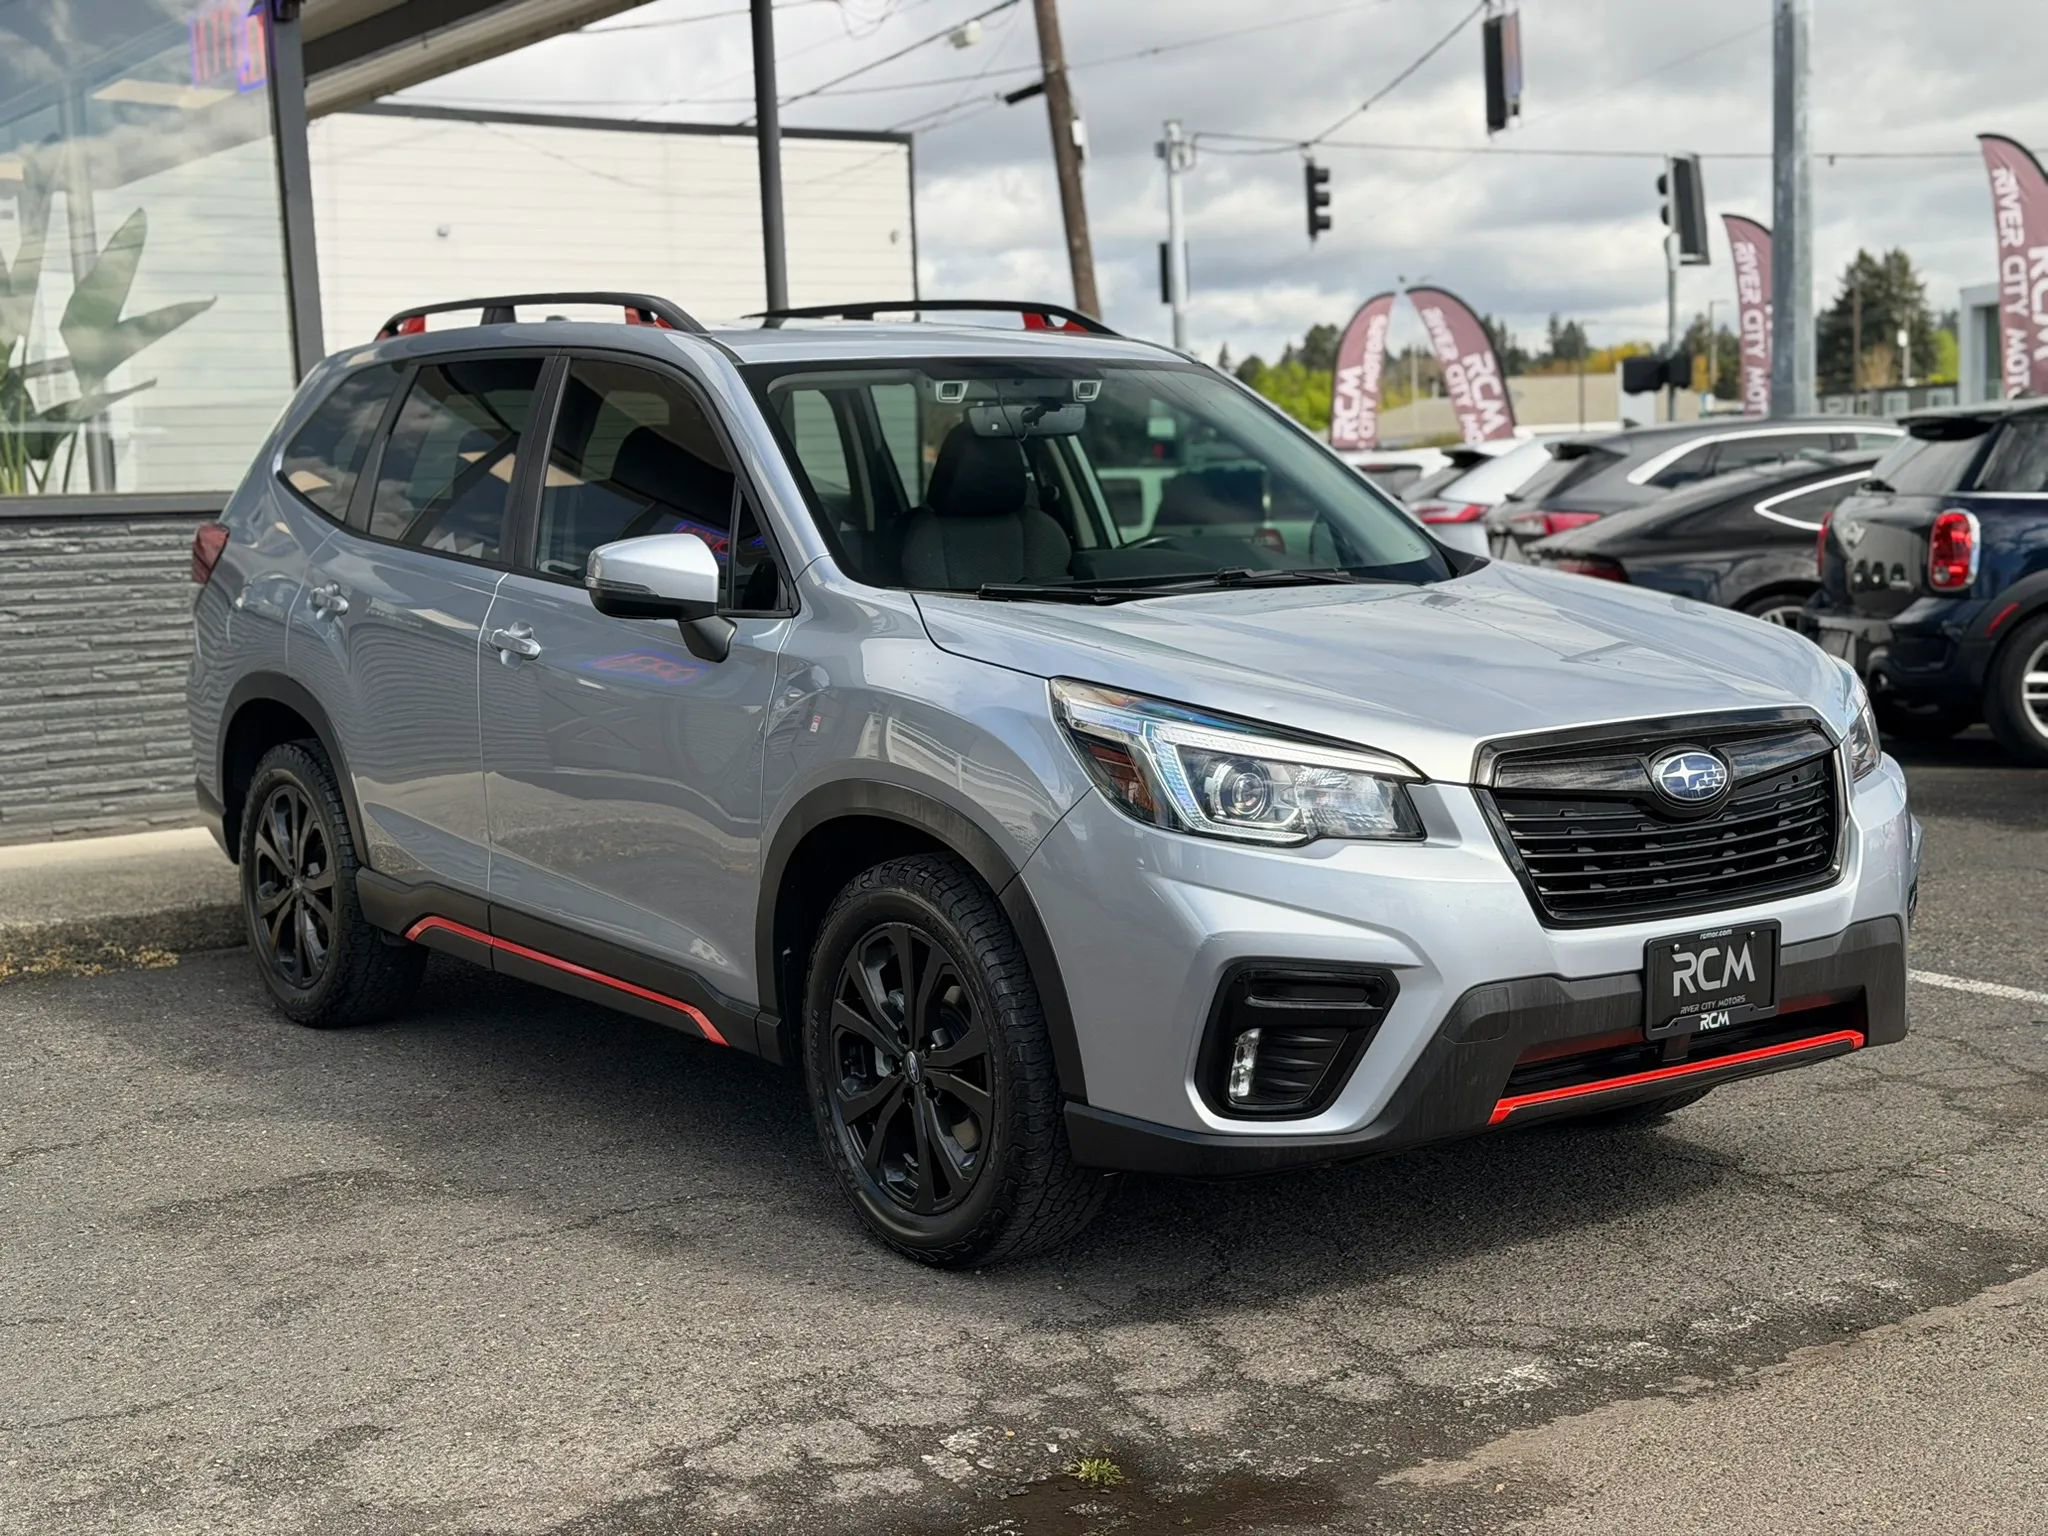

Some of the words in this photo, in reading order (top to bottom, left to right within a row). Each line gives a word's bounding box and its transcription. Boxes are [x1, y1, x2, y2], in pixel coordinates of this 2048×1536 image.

[1992, 167, 2024, 249] RIVER
[1733, 241, 1762, 304] RIVER
[2002, 255, 2029, 317] CITY
[1362, 313, 1388, 393] MOTORS
[1743, 309, 1765, 360] CITY
[2005, 328, 2030, 400] MOT
[1332, 365, 1363, 441] RCM
[1445, 363, 1473, 406] CITY
[1462, 351, 1507, 436] RCM
[1358, 395, 1377, 440] CITY
[1672, 941, 1756, 997] RCM
[1680, 1003, 1700, 1015] RIVER
[1700, 1000, 1717, 1011] CITY
[1718, 995, 1746, 1008] MOTORS
[1699, 1010, 1730, 1031] RCM
